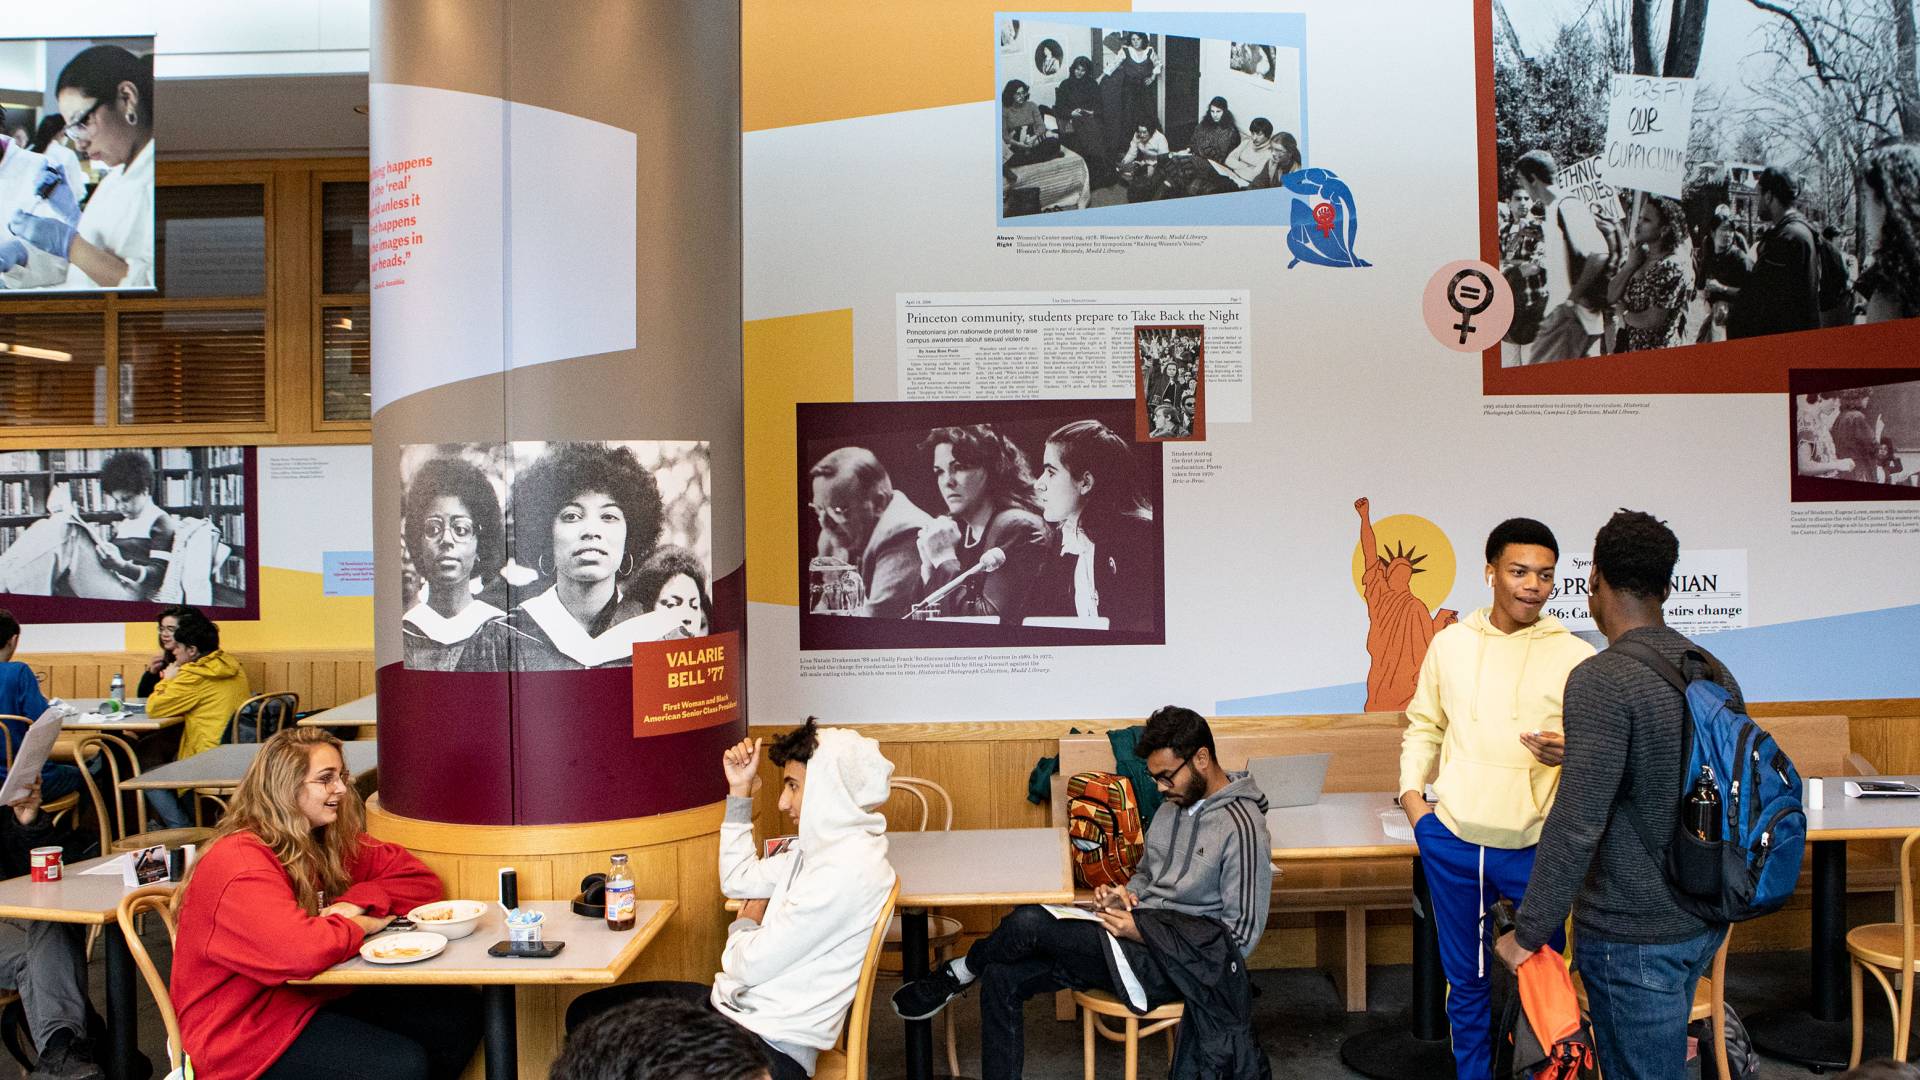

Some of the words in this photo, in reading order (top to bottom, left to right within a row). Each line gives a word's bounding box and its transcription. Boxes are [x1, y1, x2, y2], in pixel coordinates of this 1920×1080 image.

[1628, 107, 1663, 135] OUR
[386, 155, 433, 175] happens
[1558, 156, 1602, 189] ETHNIC
[1570, 180, 1614, 204] TUDIES
[381, 196, 409, 213] unless
[411, 193, 421, 208] it
[378, 216, 417, 235] happens
[379, 235, 410, 251] images
[411, 232, 423, 245] in
[907, 312, 958, 323] Princeton
[961, 312, 1025, 325] community,
[1028, 311, 1072, 322] students
[1075, 313, 1114, 325] prepare
[1117, 312, 1128, 321] to
[1131, 310, 1156, 321] Take
[1160, 310, 1185, 321] Back
[1188, 310, 1206, 321] the
[1209, 310, 1240, 324] Night
[993, 328, 1014, 336] protest
[1572, 558, 1593, 569] Spec
[1668, 605, 1694, 616] stirs
[1697, 604, 1742, 619] change
[666, 646, 724, 668] VALARIE
[668, 670, 705, 689] BELL
[707, 665, 724, 682] '77
[643, 713, 681, 723] American
[681, 709, 702, 719] Senior
[702, 706, 718, 715] Class
[718, 701, 737, 712] President
[662, 702, 680, 712] First
[681, 700, 705, 710] Woman
[706, 696, 716, 705] and
[716, 693, 729, 703] Black
